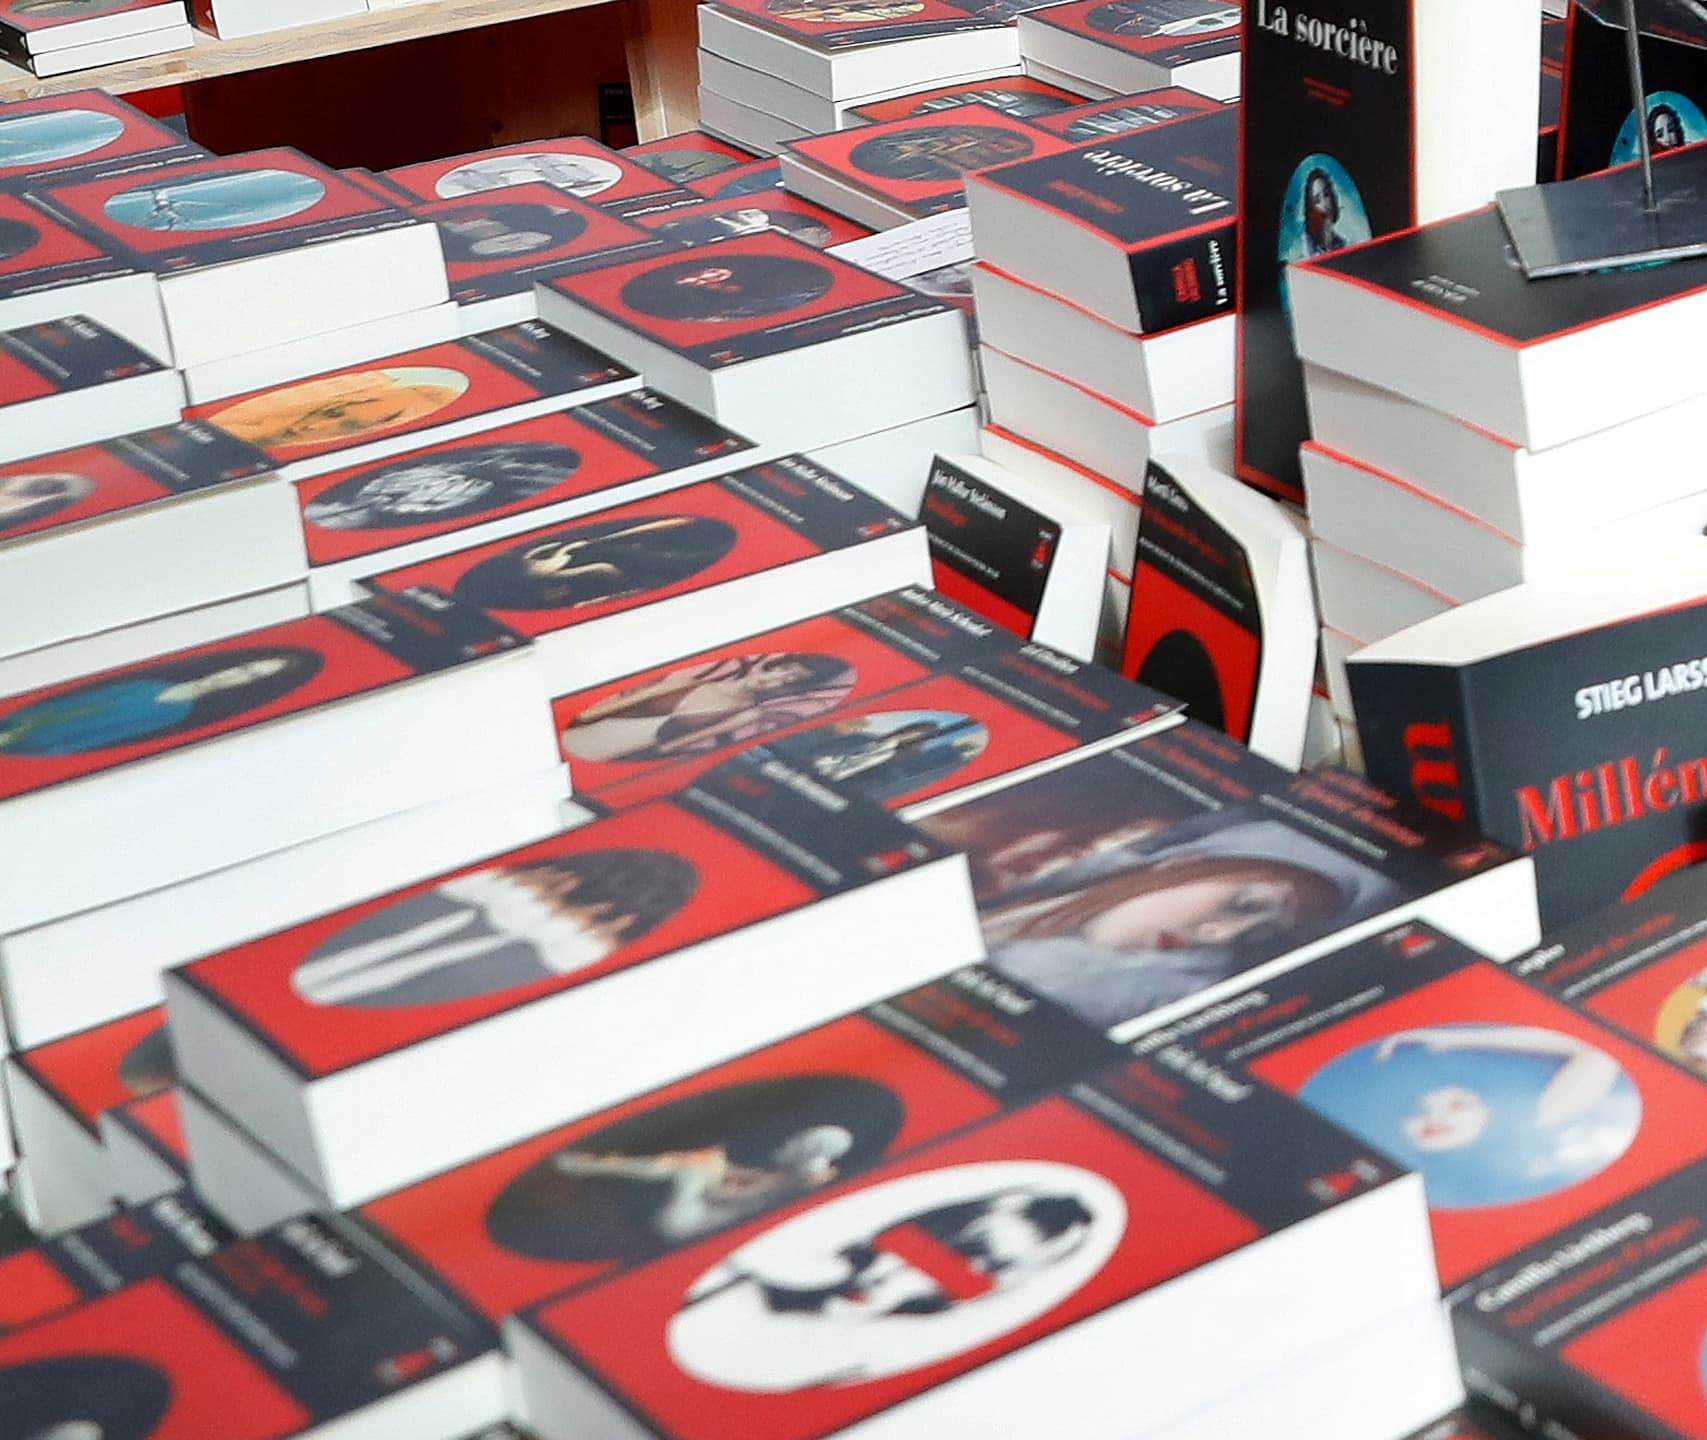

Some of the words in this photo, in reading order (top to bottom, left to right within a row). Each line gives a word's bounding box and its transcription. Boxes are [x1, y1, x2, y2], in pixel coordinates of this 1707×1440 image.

[1294, 13, 1399, 75] sorcière
[1083, 150, 1193, 192] sorcière
[1183, 189, 1233, 215] La
[1574, 674, 1642, 720] STIEG
